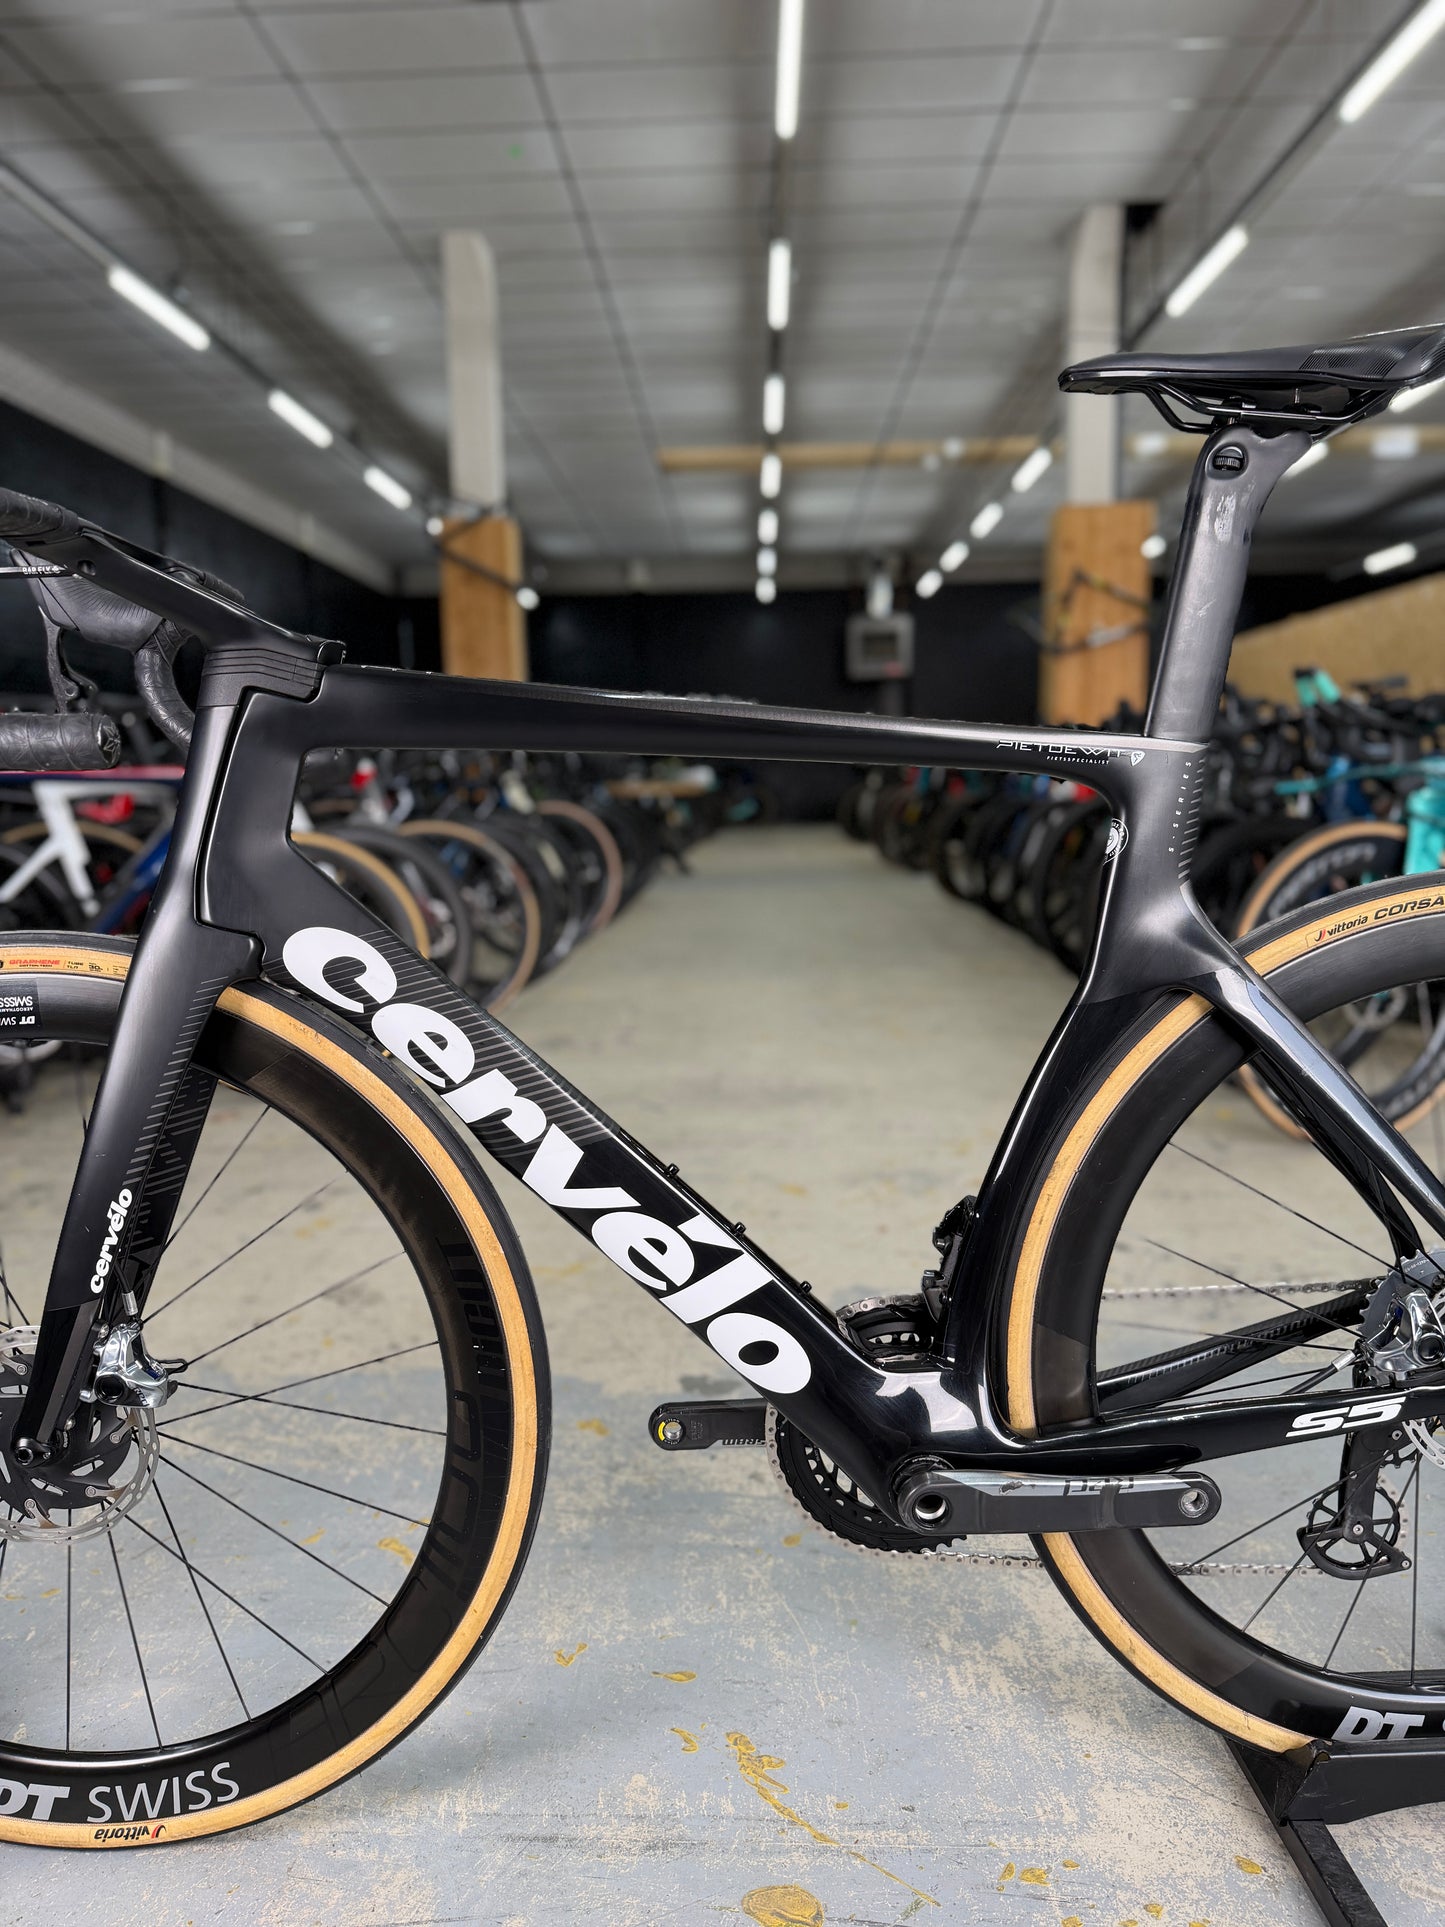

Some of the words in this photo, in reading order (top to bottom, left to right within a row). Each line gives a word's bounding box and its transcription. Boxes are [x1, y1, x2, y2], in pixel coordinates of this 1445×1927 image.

[1046, 755, 1110, 765] FIETSSPECIALIST
[1326, 914, 1369, 936] vittoria
[1373, 895, 1445, 920] CORSA
[282, 926, 812, 1395] cervélo
[90, 1188, 133, 1294] cervélo
[1285, 1396, 1407, 1438] S5
[1331, 1705, 1426, 1742] DT
[86, 1761, 241, 1824] SWISS
[94, 1824, 150, 1843] vittoria
